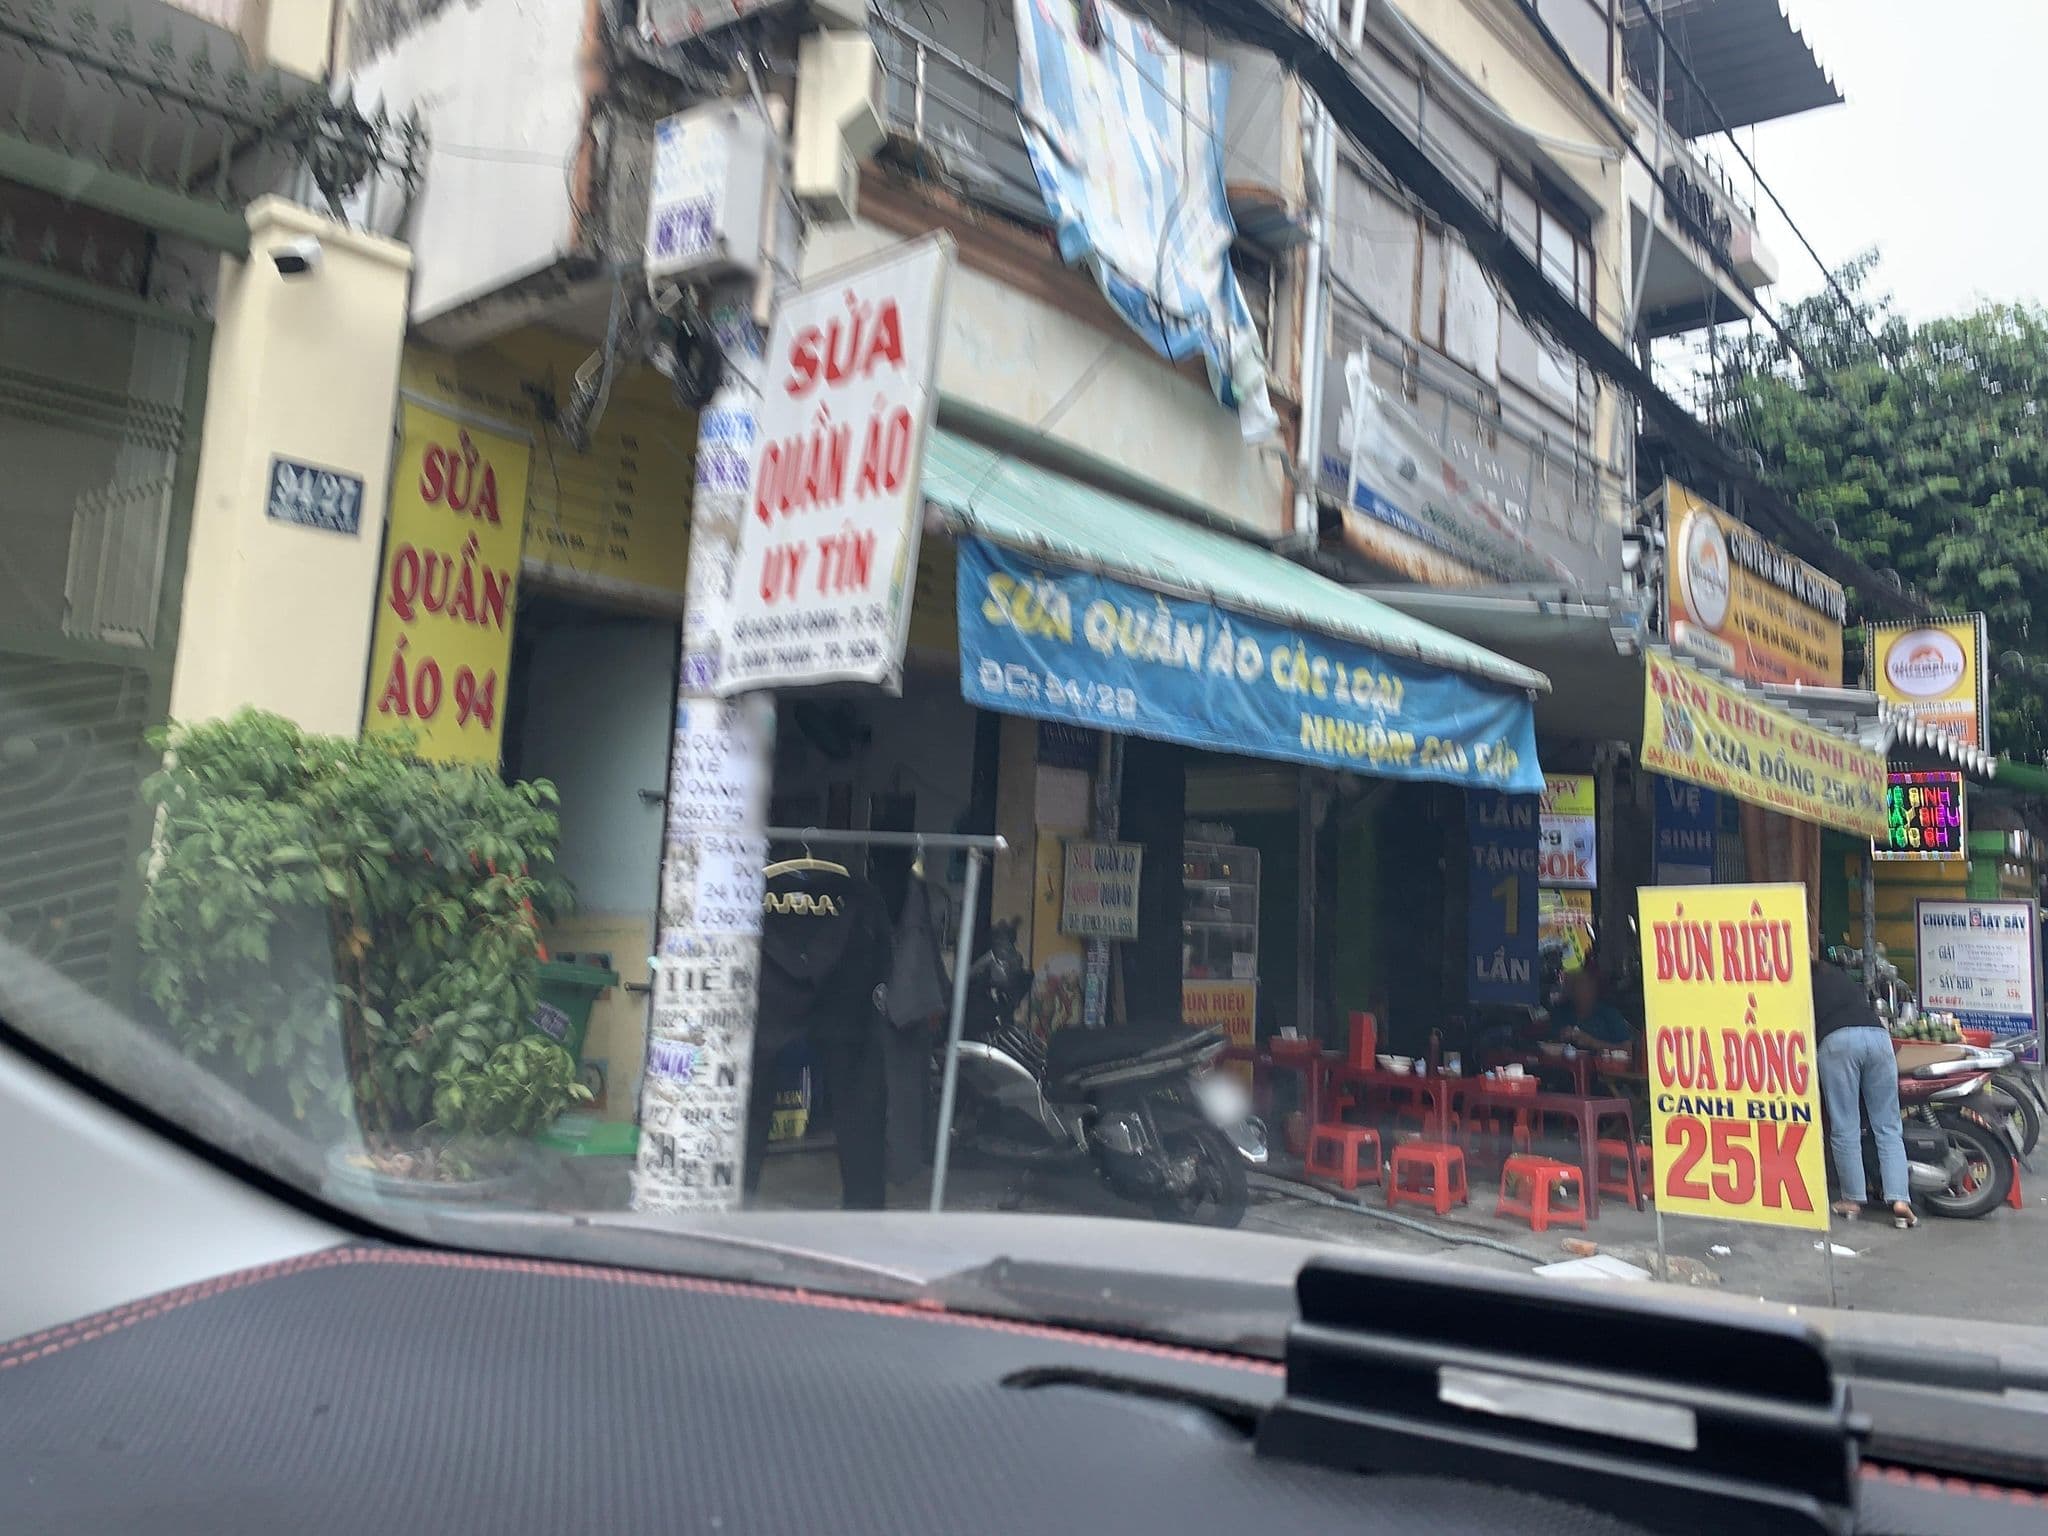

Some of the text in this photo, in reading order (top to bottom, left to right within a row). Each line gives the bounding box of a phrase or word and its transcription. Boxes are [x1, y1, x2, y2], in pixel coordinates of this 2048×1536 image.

[785, 288, 906, 396] SỬA
[420, 429, 501, 522] SỬA
[754, 400, 851, 527] QUẦN
[856, 392, 914, 499] ÁO
[390, 531, 511, 631] QUẦN
[759, 519, 875, 605] UY TÍN
[378, 632, 496, 729] ÁO 94
[982, 570, 1404, 722] SỬA QUẦN ÁO CÁC LOẠI
[1704, 730, 1751, 775] CUA
[1759, 747, 1816, 797] ĐỒNG
[1790, 728, 1843, 770] CANH
[1492, 876, 1518, 936] 1
[1653, 898, 1793, 983] BÚN RIÊU
[1923, 912, 1967, 928] CHUYÊN
[2004, 911, 2026, 929] SẤY
[1477, 944, 1530, 984] LẦN
[1656, 992, 1810, 1096] CUA ĐỒNG
[1657, 1093, 1811, 1123] CANH BÚN
[1665, 1115, 1815, 1212] 25K
